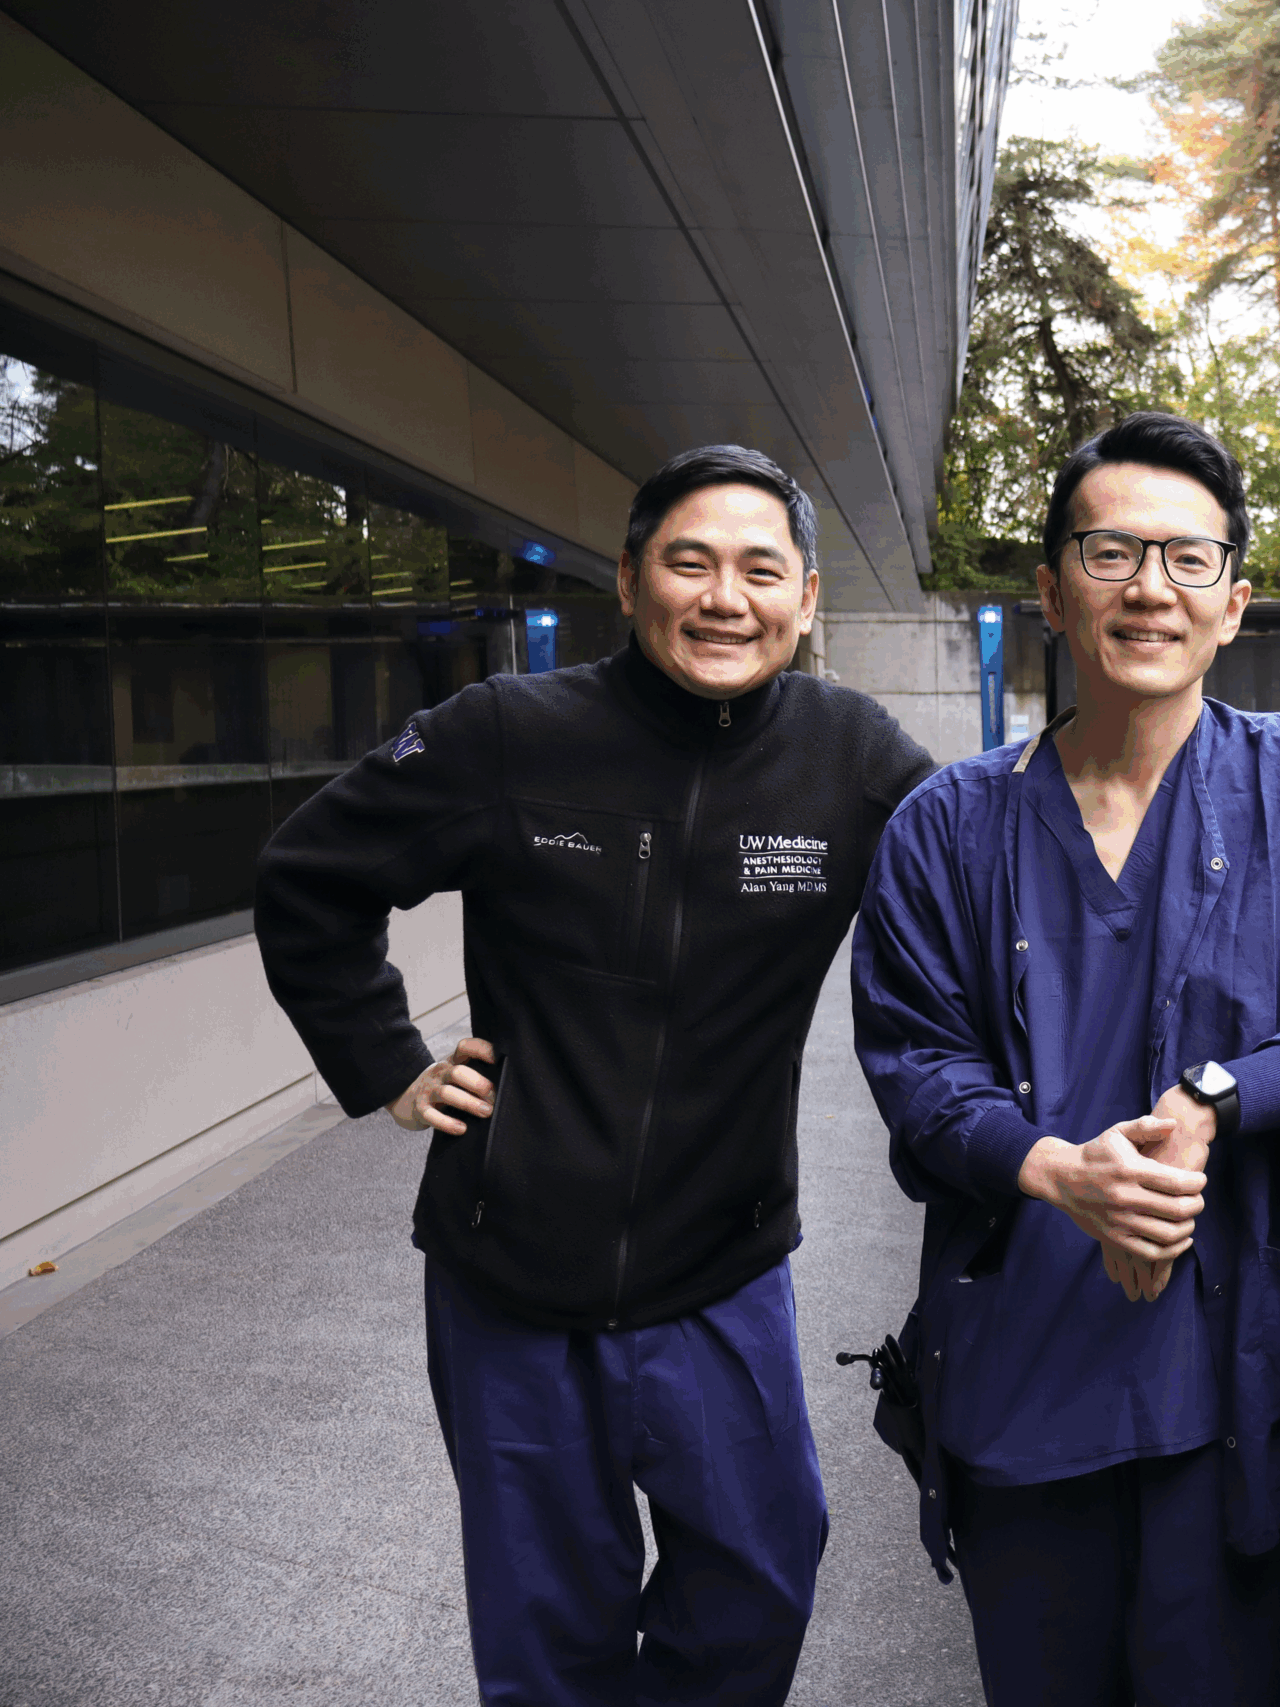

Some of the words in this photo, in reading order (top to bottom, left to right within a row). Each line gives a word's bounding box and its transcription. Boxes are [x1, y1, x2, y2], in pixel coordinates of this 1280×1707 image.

[533, 836, 565, 847] EDDIE
[739, 834, 766, 850] UW
[767, 835, 828, 850] Medicine
[743, 855, 822, 865] ANESTHESIOLOGY
[743, 867, 751, 875] &
[754, 866, 778, 875] PAIN
[781, 865, 822, 875] MEDICINE
[741, 882, 767, 893] Alan
[769, 880, 795, 893] Yang
